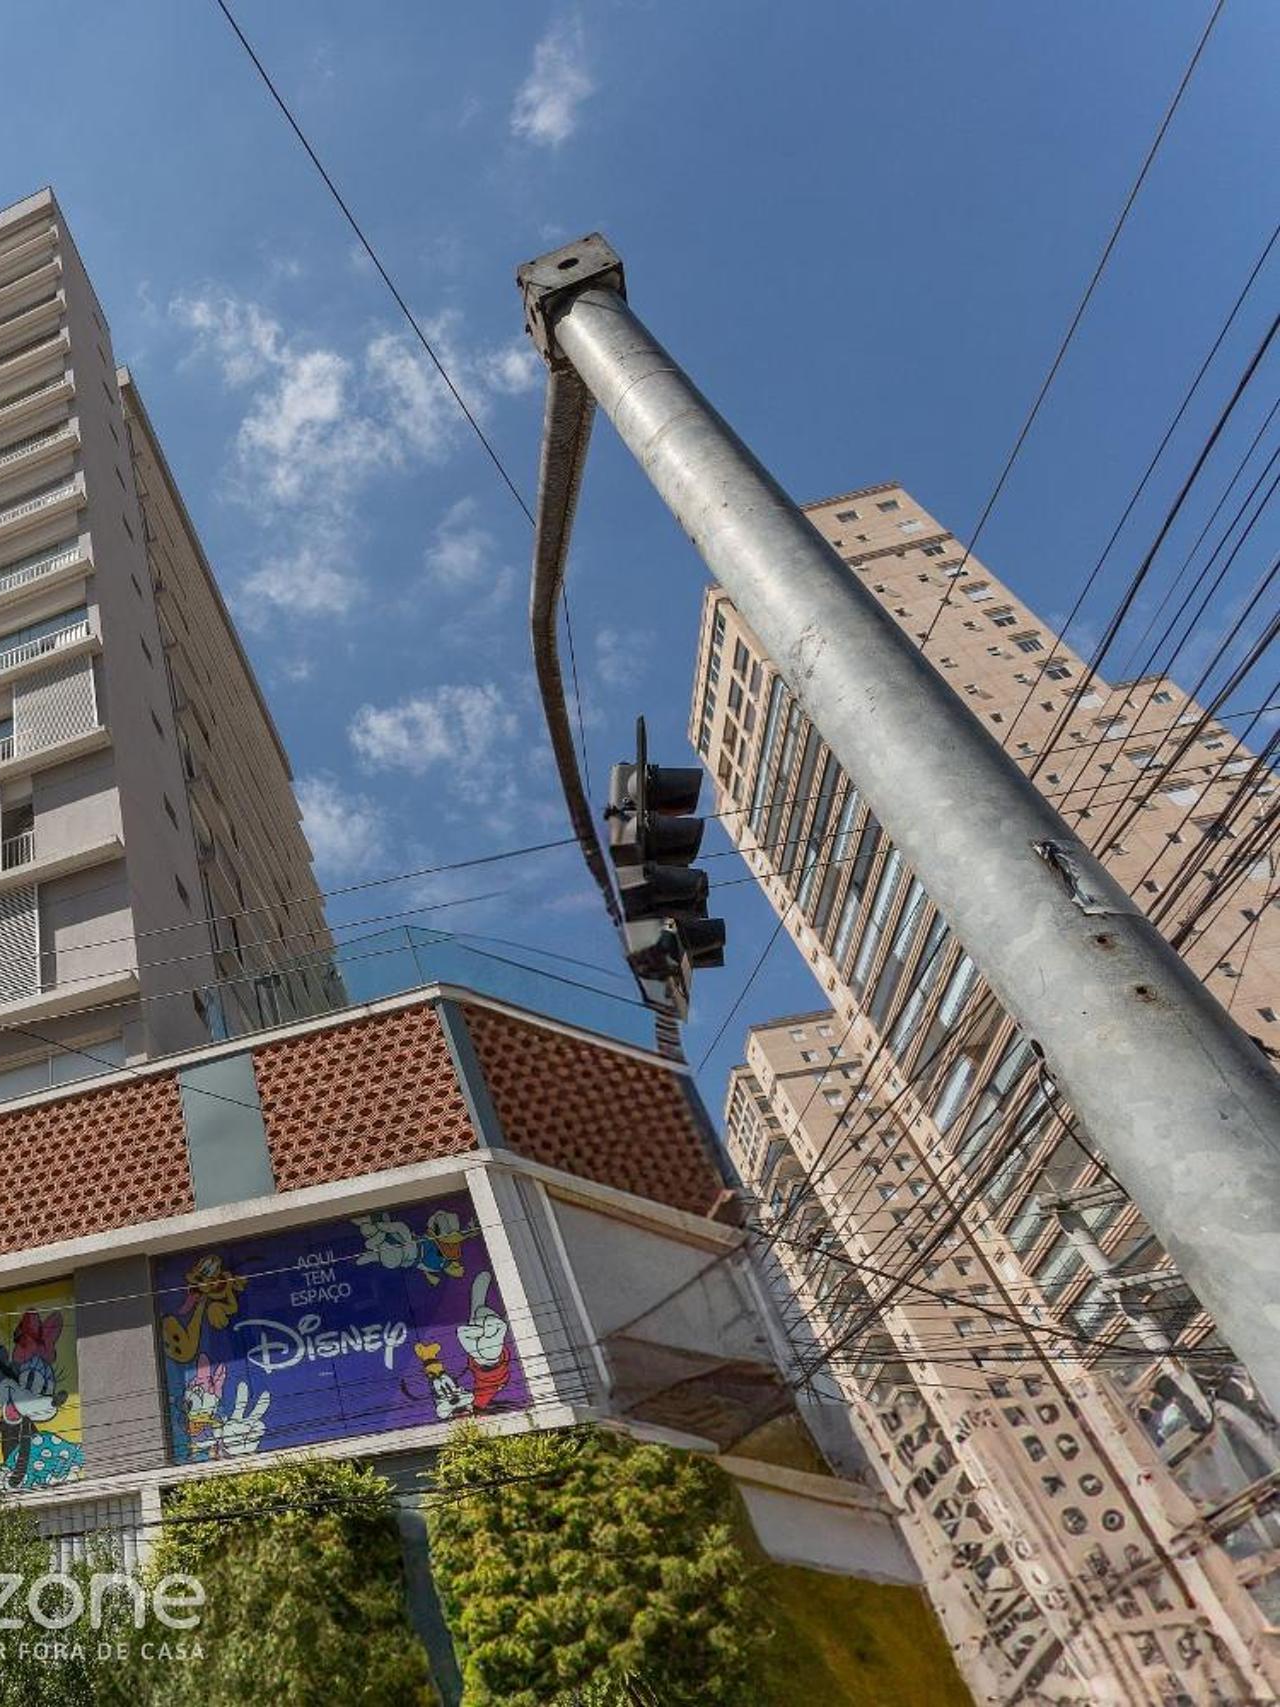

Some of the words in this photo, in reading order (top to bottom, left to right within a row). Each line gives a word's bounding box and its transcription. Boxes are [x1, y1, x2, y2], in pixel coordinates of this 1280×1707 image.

[297, 1250, 334, 1268] AQUI
[303, 1268, 336, 1287] TEM
[290, 1282, 351, 1307] ESPAÇO
